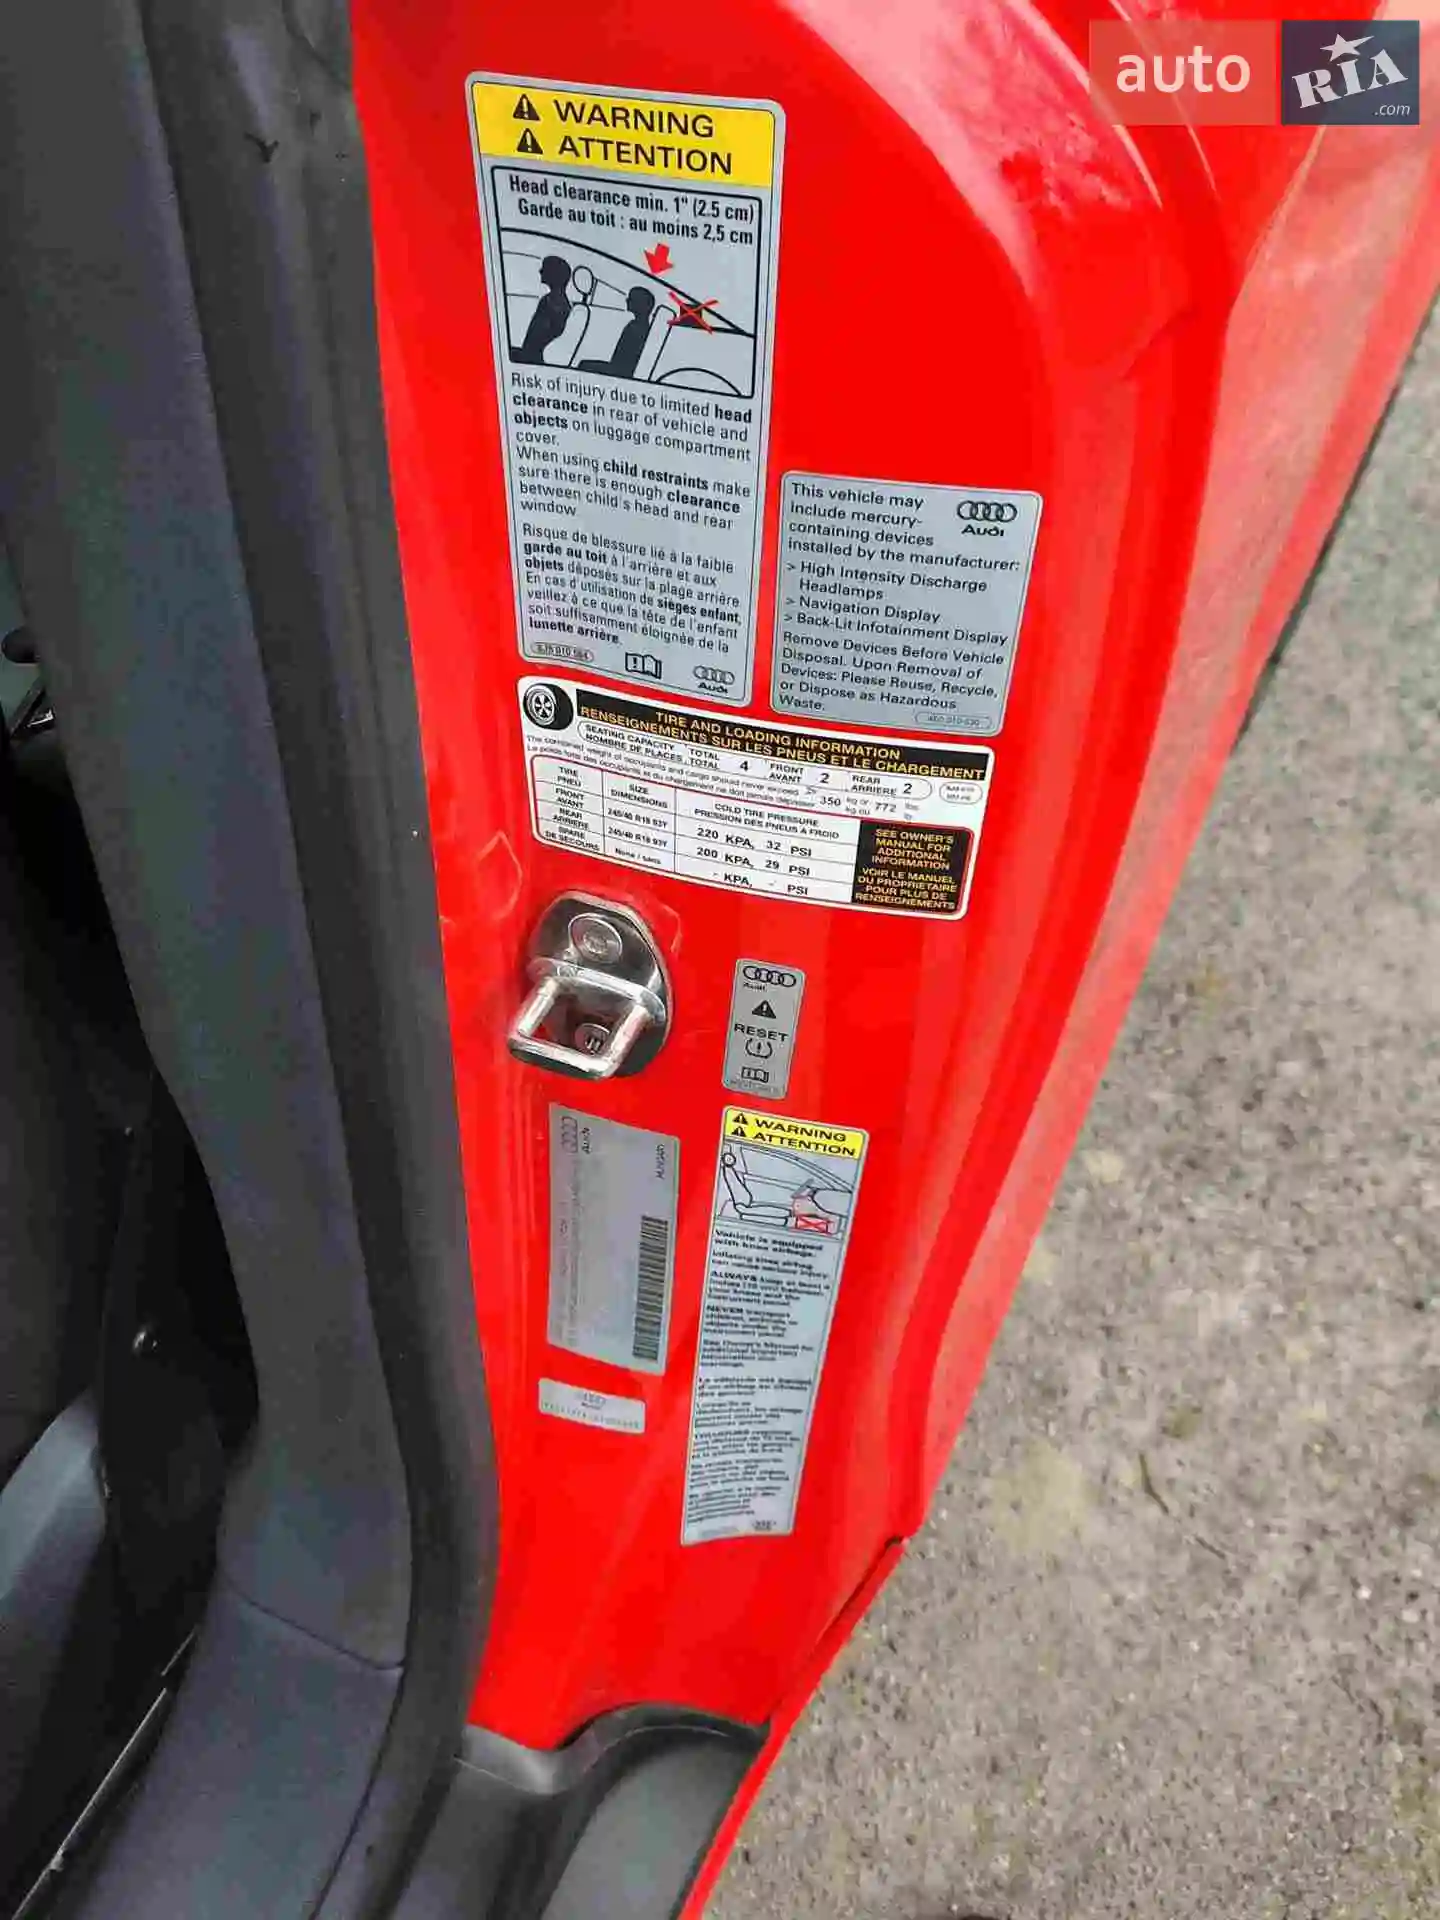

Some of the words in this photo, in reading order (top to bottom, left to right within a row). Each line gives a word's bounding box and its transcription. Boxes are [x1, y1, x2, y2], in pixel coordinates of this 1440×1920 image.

[554, 99, 714, 138] WARNING
[559, 136, 732, 175] ATTENTION
[510, 175, 548, 196] Head
[554, 183, 630, 207] clearance
[636, 193, 668, 212] min.
[726, 203, 754, 223] cm)
[518, 199, 563, 220] Garde
[568, 209, 586, 224] au
[590, 209, 616, 227] toit
[629, 215, 648, 231] au
[652, 218, 699, 238] moins
[730, 230, 753, 244] cm
[511, 373, 542, 390] Risk
[546, 378, 561, 392] of
[565, 380, 606, 399] injury
[610, 388, 637, 404] due
[641, 393, 656, 408] to
[660, 394, 709, 416] limited
[715, 404, 752, 423] head
[513, 393, 588, 414] clearance
[593, 401, 605, 416] in
[610, 408, 639, 422] rear
[644, 412, 658, 426] of
[662, 415, 715, 436] vehicle
[720, 425, 748, 441] and
[514, 412, 568, 430] objects
[572, 419, 590, 433] on
[594, 420, 650, 445] luggage
[655, 433, 750, 462] compartment
[516, 431, 560, 446] cover.
[516, 446, 558, 464] When
[563, 452, 599, 472] using
[603, 458, 638, 477] child
[642, 467, 709, 490] restraints
[712, 479, 750, 498] make
[518, 465, 550, 479] sure
[555, 467, 591, 485] there
[611, 477, 669, 500] enough
[667, 490, 740, 514] clearance
[792, 482, 824, 499] This
[829, 487, 884, 505] vehicle
[890, 495, 924, 510] may
[520, 482, 580, 500] between
[635, 499, 669, 517] head
[673, 505, 699, 523] and
[704, 511, 732, 530] rear
[790, 503, 847, 519] include
[851, 507, 922, 528] mercury-
[789, 521, 876, 542] containing
[874, 528, 934, 546] devices
[961, 524, 1004, 537] Audi
[523, 523, 567, 543] Risque
[572, 529, 588, 544] de
[591, 531, 647, 557] blessure
[697, 552, 734, 573] faible
[788, 539, 852, 557] installed
[857, 547, 876, 561] by
[880, 550, 905, 562] the
[909, 551, 1021, 571] manufacturer:
[523, 542, 562, 557] garde
[566, 547, 582, 560] au
[585, 548, 607, 564] toit
[694, 573, 717, 586] aux
[801, 561, 835, 578] High
[840, 566, 905, 587] Intensity
[910, 573, 987, 593] Discharge
[525, 558, 564, 575] objets
[622, 570, 640, 585] sur
[659, 577, 693, 600] plage
[526, 572, 541, 585] En
[800, 579, 884, 600] Headlamps
[601, 599, 624, 615] que
[799, 597, 880, 617] Navigation
[884, 605, 941, 624] Display
[530, 617, 573, 634] lunette
[797, 613, 853, 630] Back-Lit
[857, 618, 949, 640] Infotainment
[954, 629, 1008, 646] Display
[783, 632, 839, 649] Remove
[844, 639, 898, 656] Devices
[902, 646, 948, 660] Before
[953, 650, 1004, 666] Vehicle
[841, 672, 886, 687] Please
[852, 658, 892, 672] Upon
[897, 662, 962, 678] Removal
[698, 682, 728, 693] Audi
[799, 680, 855, 700] Dispose
[880, 692, 956, 710] Hazardous
[581, 706, 708, 743] RENSEIGNEMENTS
[711, 737, 741, 749] SUR
[745, 743, 772, 755] LES
[776, 745, 827, 764] PNEUS
[830, 754, 848, 765] ET
[853, 758, 871, 769] LE
[875, 761, 984, 779] CHARGEMENT
[656, 712, 687, 726] TIRE
[691, 720, 721, 733] AND
[725, 728, 791, 747] LOADING
[795, 737, 900, 759] INFORMATION
[585, 734, 626, 750] NOMBRE
[645, 748, 683, 761] PLACES
[690, 757, 720, 770] TOTAL
[769, 773, 801, 783] AVANT
[585, 724, 625, 740] SEATING
[629, 735, 675, 750] CAPACITY
[689, 747, 720, 761] TOTAL
[739, 760, 748, 771] 4
[770, 763, 803, 775] FRONT
[820, 773, 829, 783] 2
[903, 783, 912, 794] 2
[611, 788, 668, 809] DIMENSIONS
[628, 784, 649, 795] SIZE
[714, 803, 741, 814] COLD
[768, 813, 819, 826] PRESSURE
[820, 796, 841, 806] 350
[875, 802, 896, 812] 772
[694, 809, 742, 823] PRESSION
[765, 822, 797, 833] PNEUS
[875, 829, 897, 838] SEE
[697, 828, 718, 839] 220
[766, 841, 781, 850] 32
[790, 846, 811, 856] PSI
[875, 838, 924, 850] MANUAL
[927, 844, 951, 852] FOR
[878, 848, 945, 860] ADDITIONAL
[697, 847, 718, 858] 200
[765, 860, 780, 869] 29
[789, 865, 810, 876] PSI
[872, 856, 950, 870] INFORMATION
[863, 868, 888, 877] VOIR
[908, 872, 955, 883] MANUEL
[788, 885, 808, 895] PSI
[866, 885, 897, 895] POUR
[734, 1024, 789, 1042] RESET
[755, 1117, 846, 1142] WARNING
[753, 1132, 855, 1157] ATTENTION
